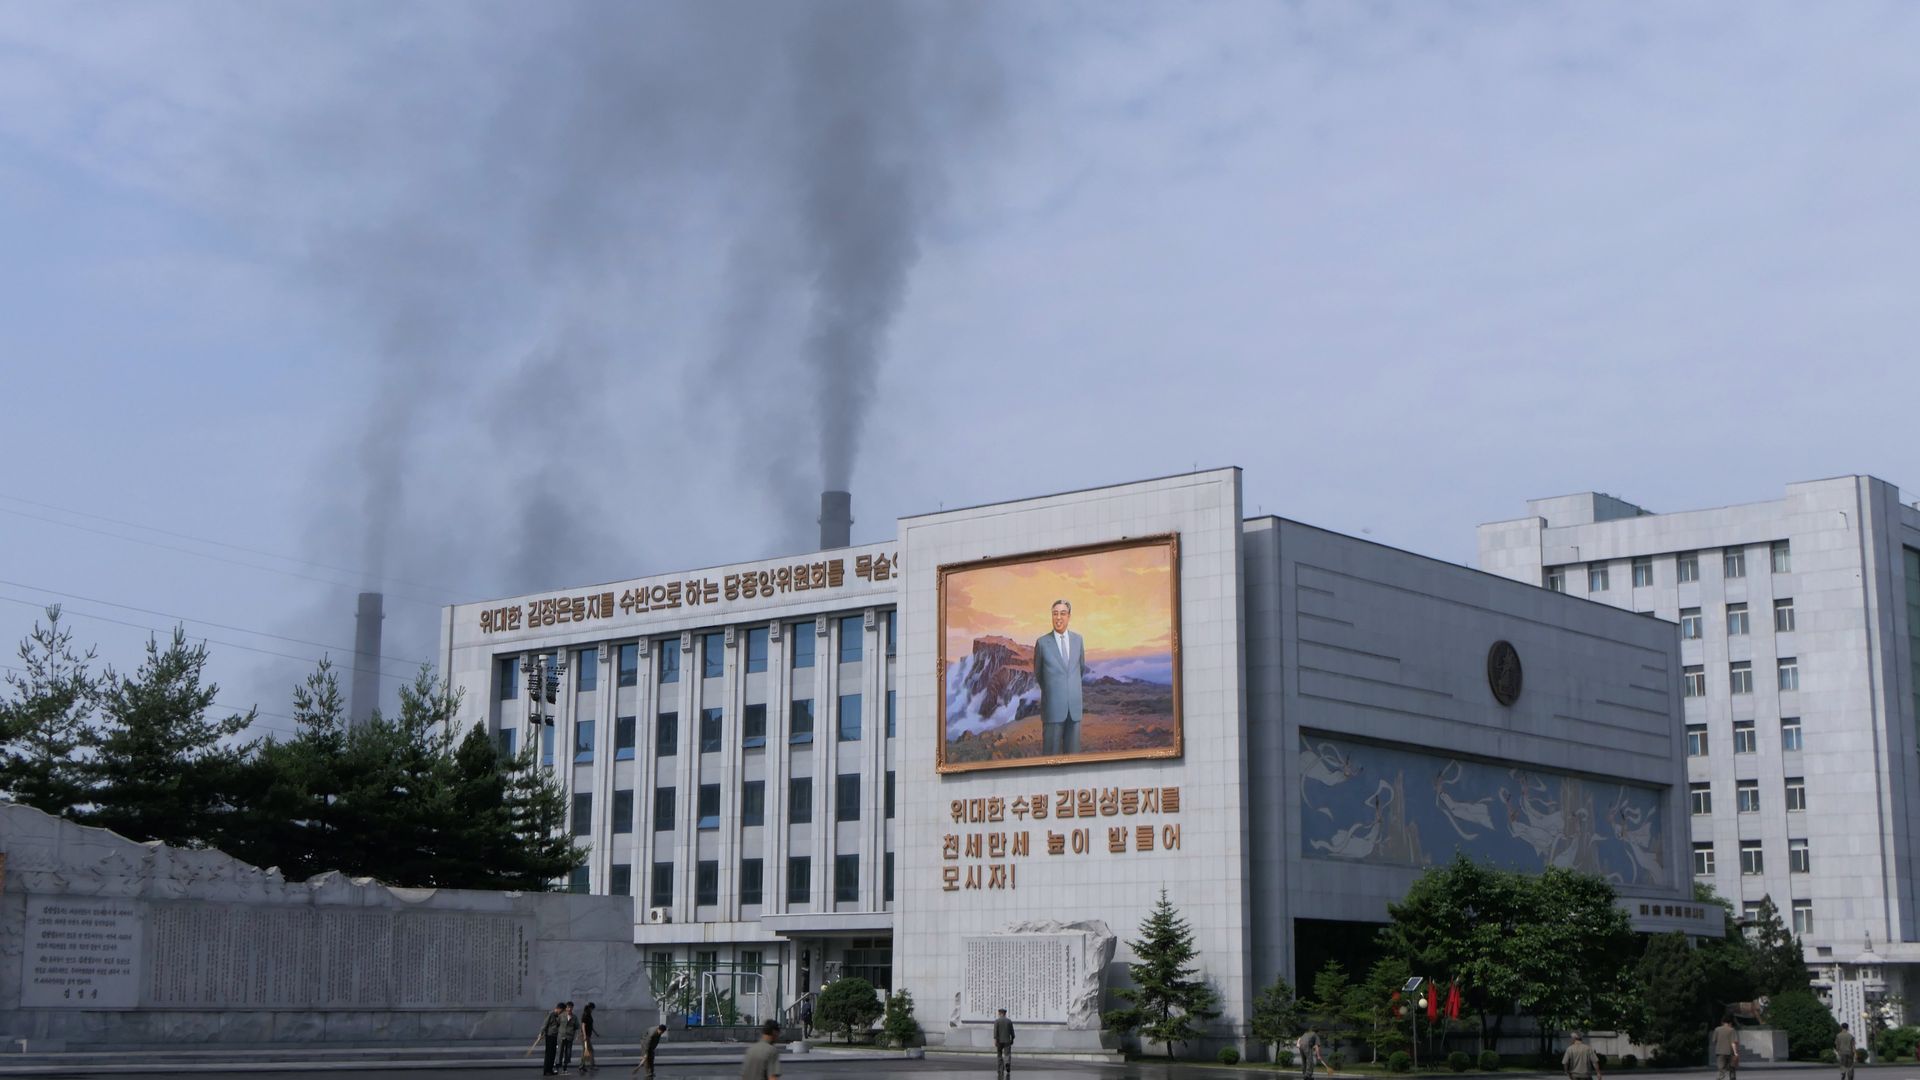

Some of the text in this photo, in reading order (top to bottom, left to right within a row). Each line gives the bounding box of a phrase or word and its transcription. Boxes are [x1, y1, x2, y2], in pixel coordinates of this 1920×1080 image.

[479, 604, 523, 634] 위대한
[527, 591, 615, 629] 김정은동지를
[620, 581, 682, 615] 수반으로
[685, 577, 719, 606] 하는
[724, 558, 845, 601] 당중앙위원회를
[950, 786, 1180, 824] 위대한 수령 김일성동지를
[943, 823, 1181, 860] 천세만세 높이 받들어
[942, 863, 1016, 891] 모시자!
